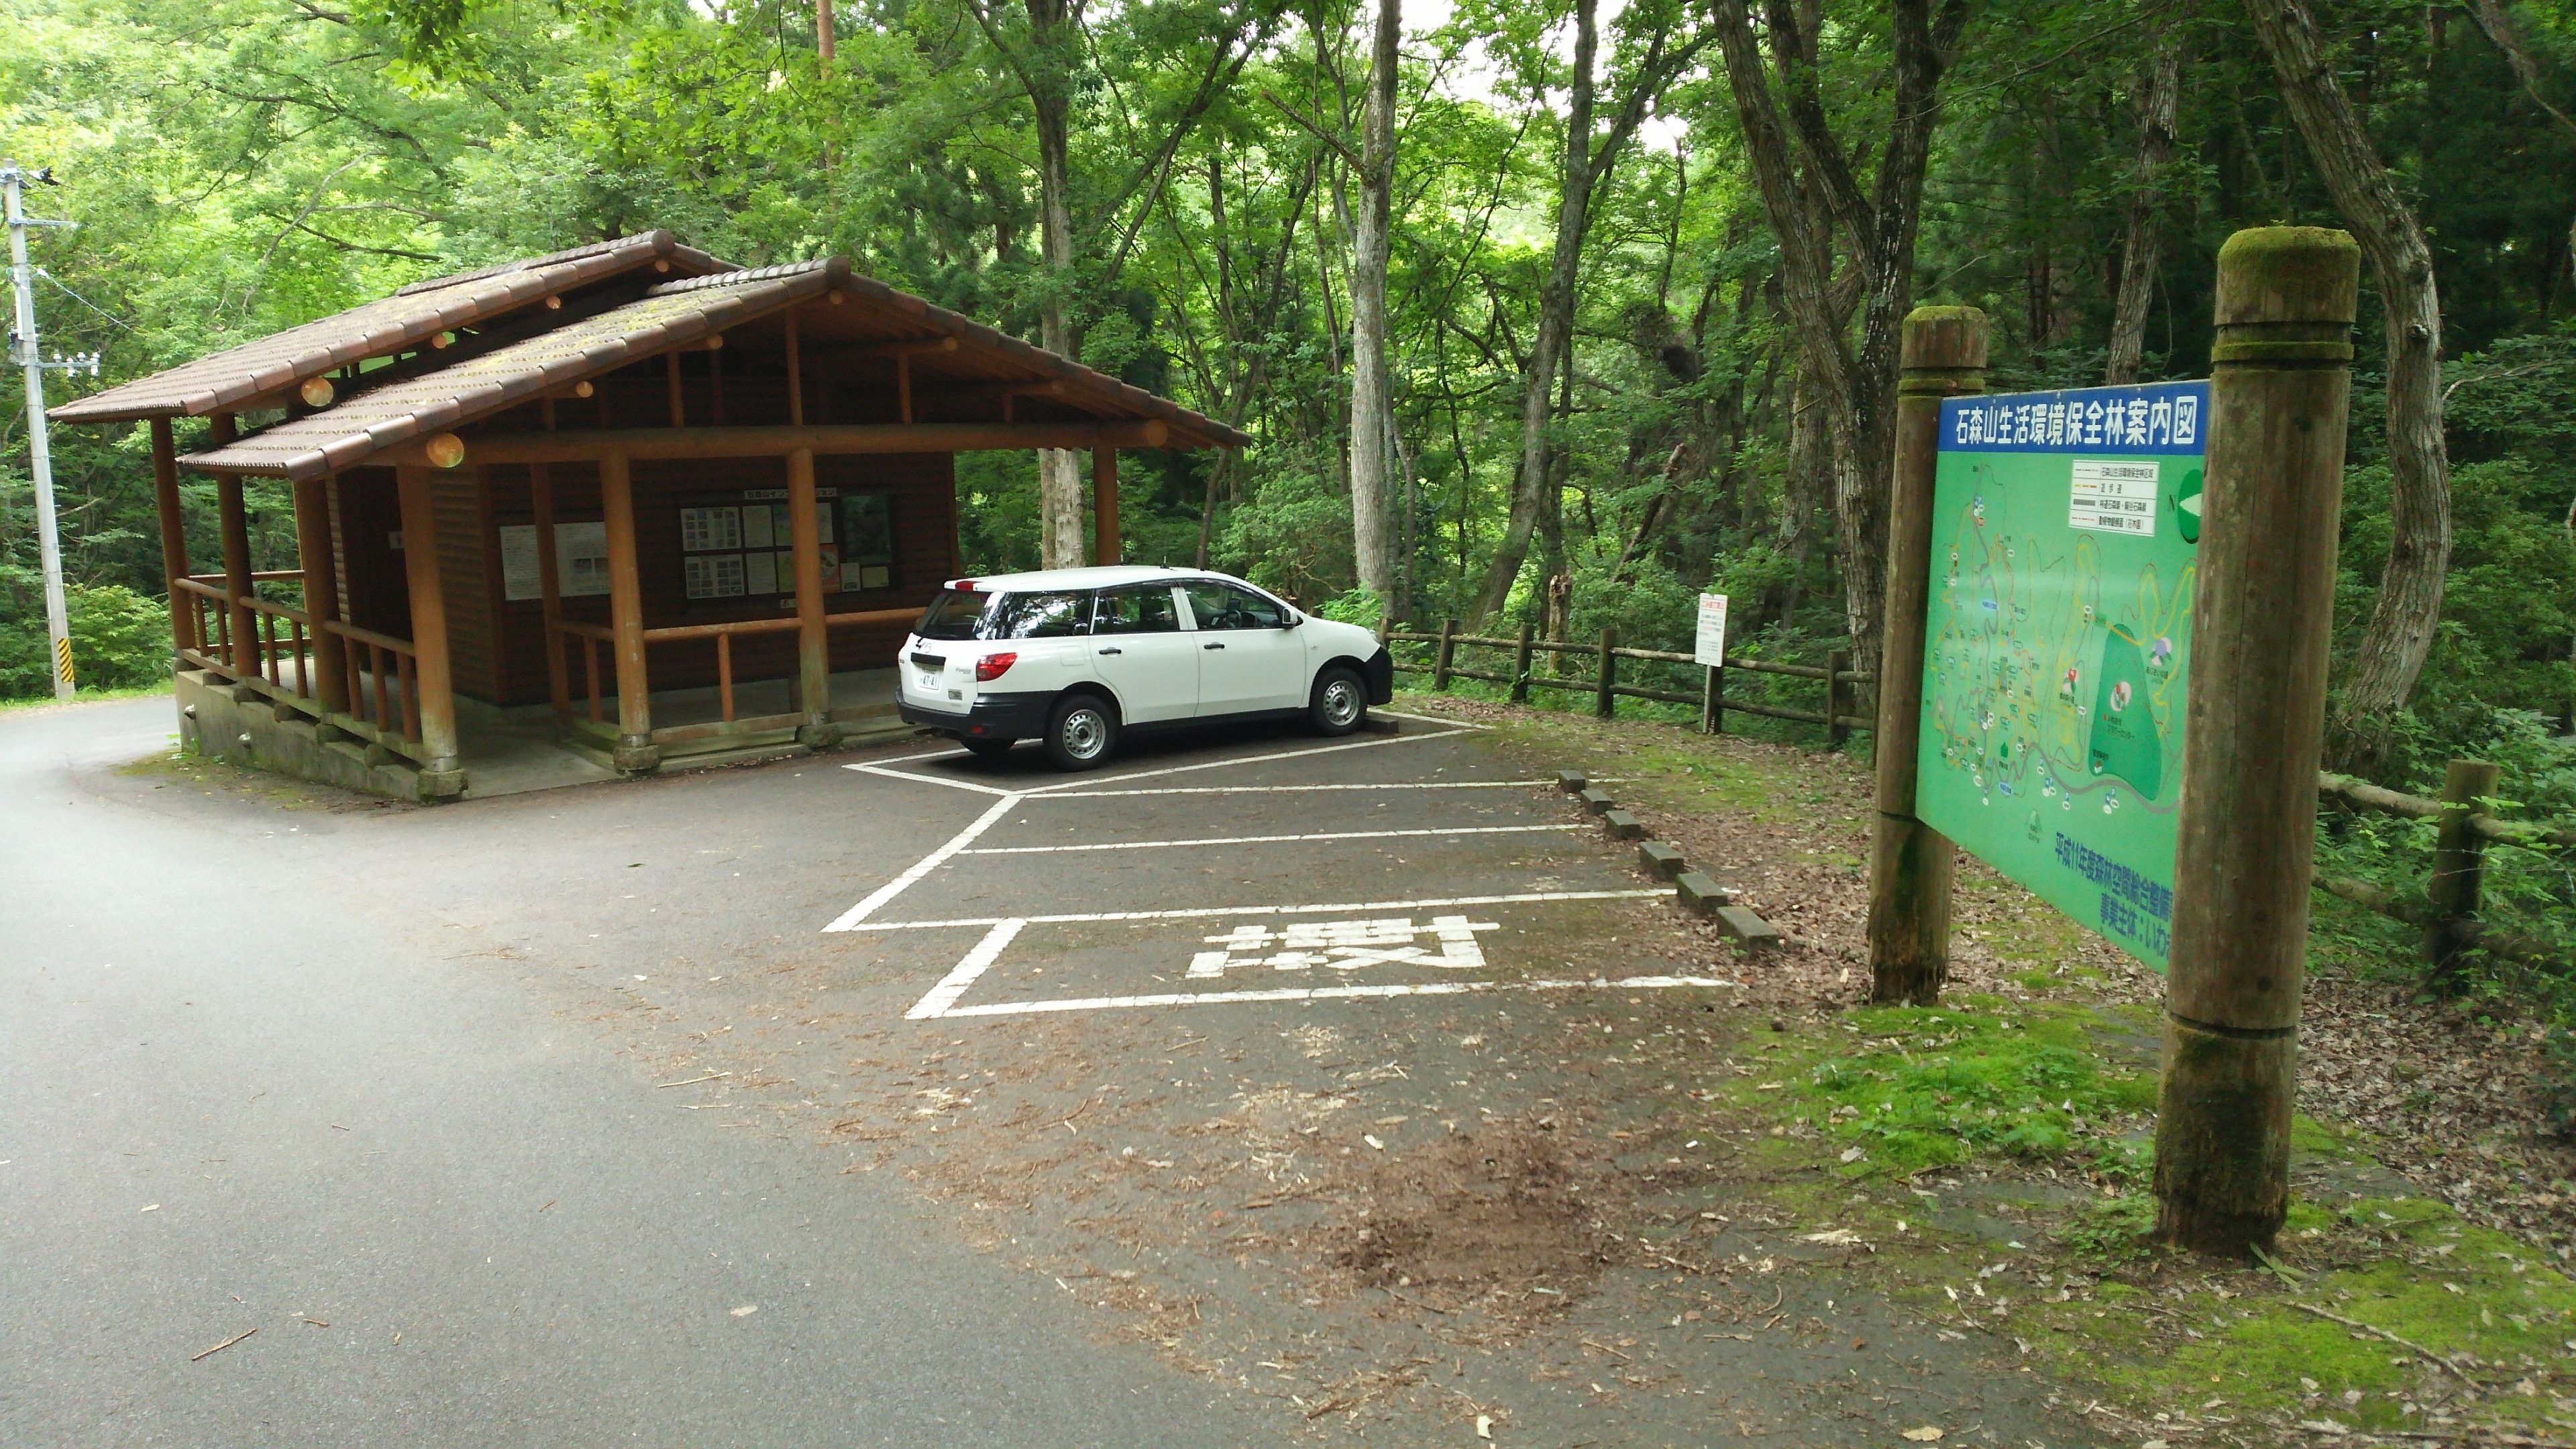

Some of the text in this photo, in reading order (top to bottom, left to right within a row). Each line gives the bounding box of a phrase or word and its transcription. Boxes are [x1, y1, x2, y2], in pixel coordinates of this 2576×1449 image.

[1955, 396, 2198, 445] 石森山生活環境保全林案内図
[1185, 915, 1501, 979] 軽
